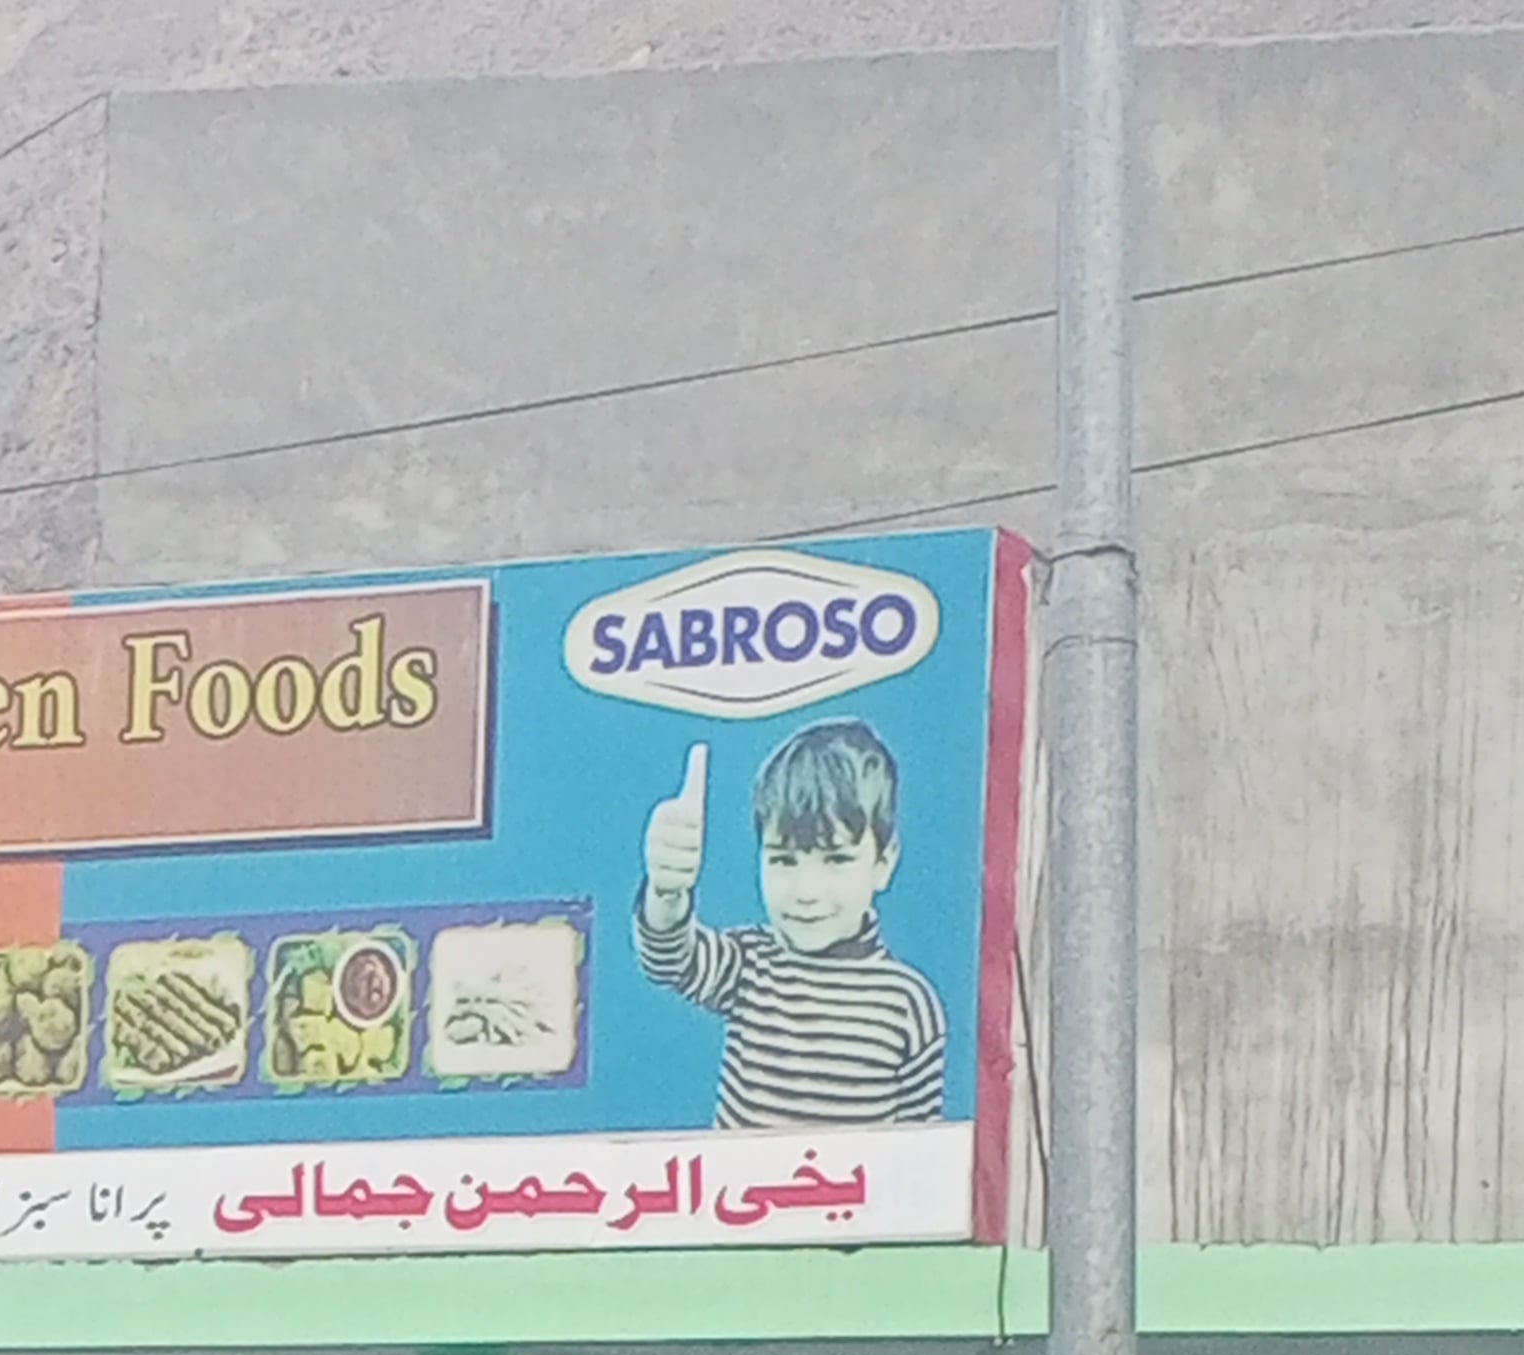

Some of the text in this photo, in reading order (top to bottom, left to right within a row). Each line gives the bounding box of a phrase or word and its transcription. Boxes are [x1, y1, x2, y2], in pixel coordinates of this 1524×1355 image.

[589, 593, 917, 675] SABROSO
[120, 613, 440, 743] Foods
[88, 1180, 172, 1241] پرانا
